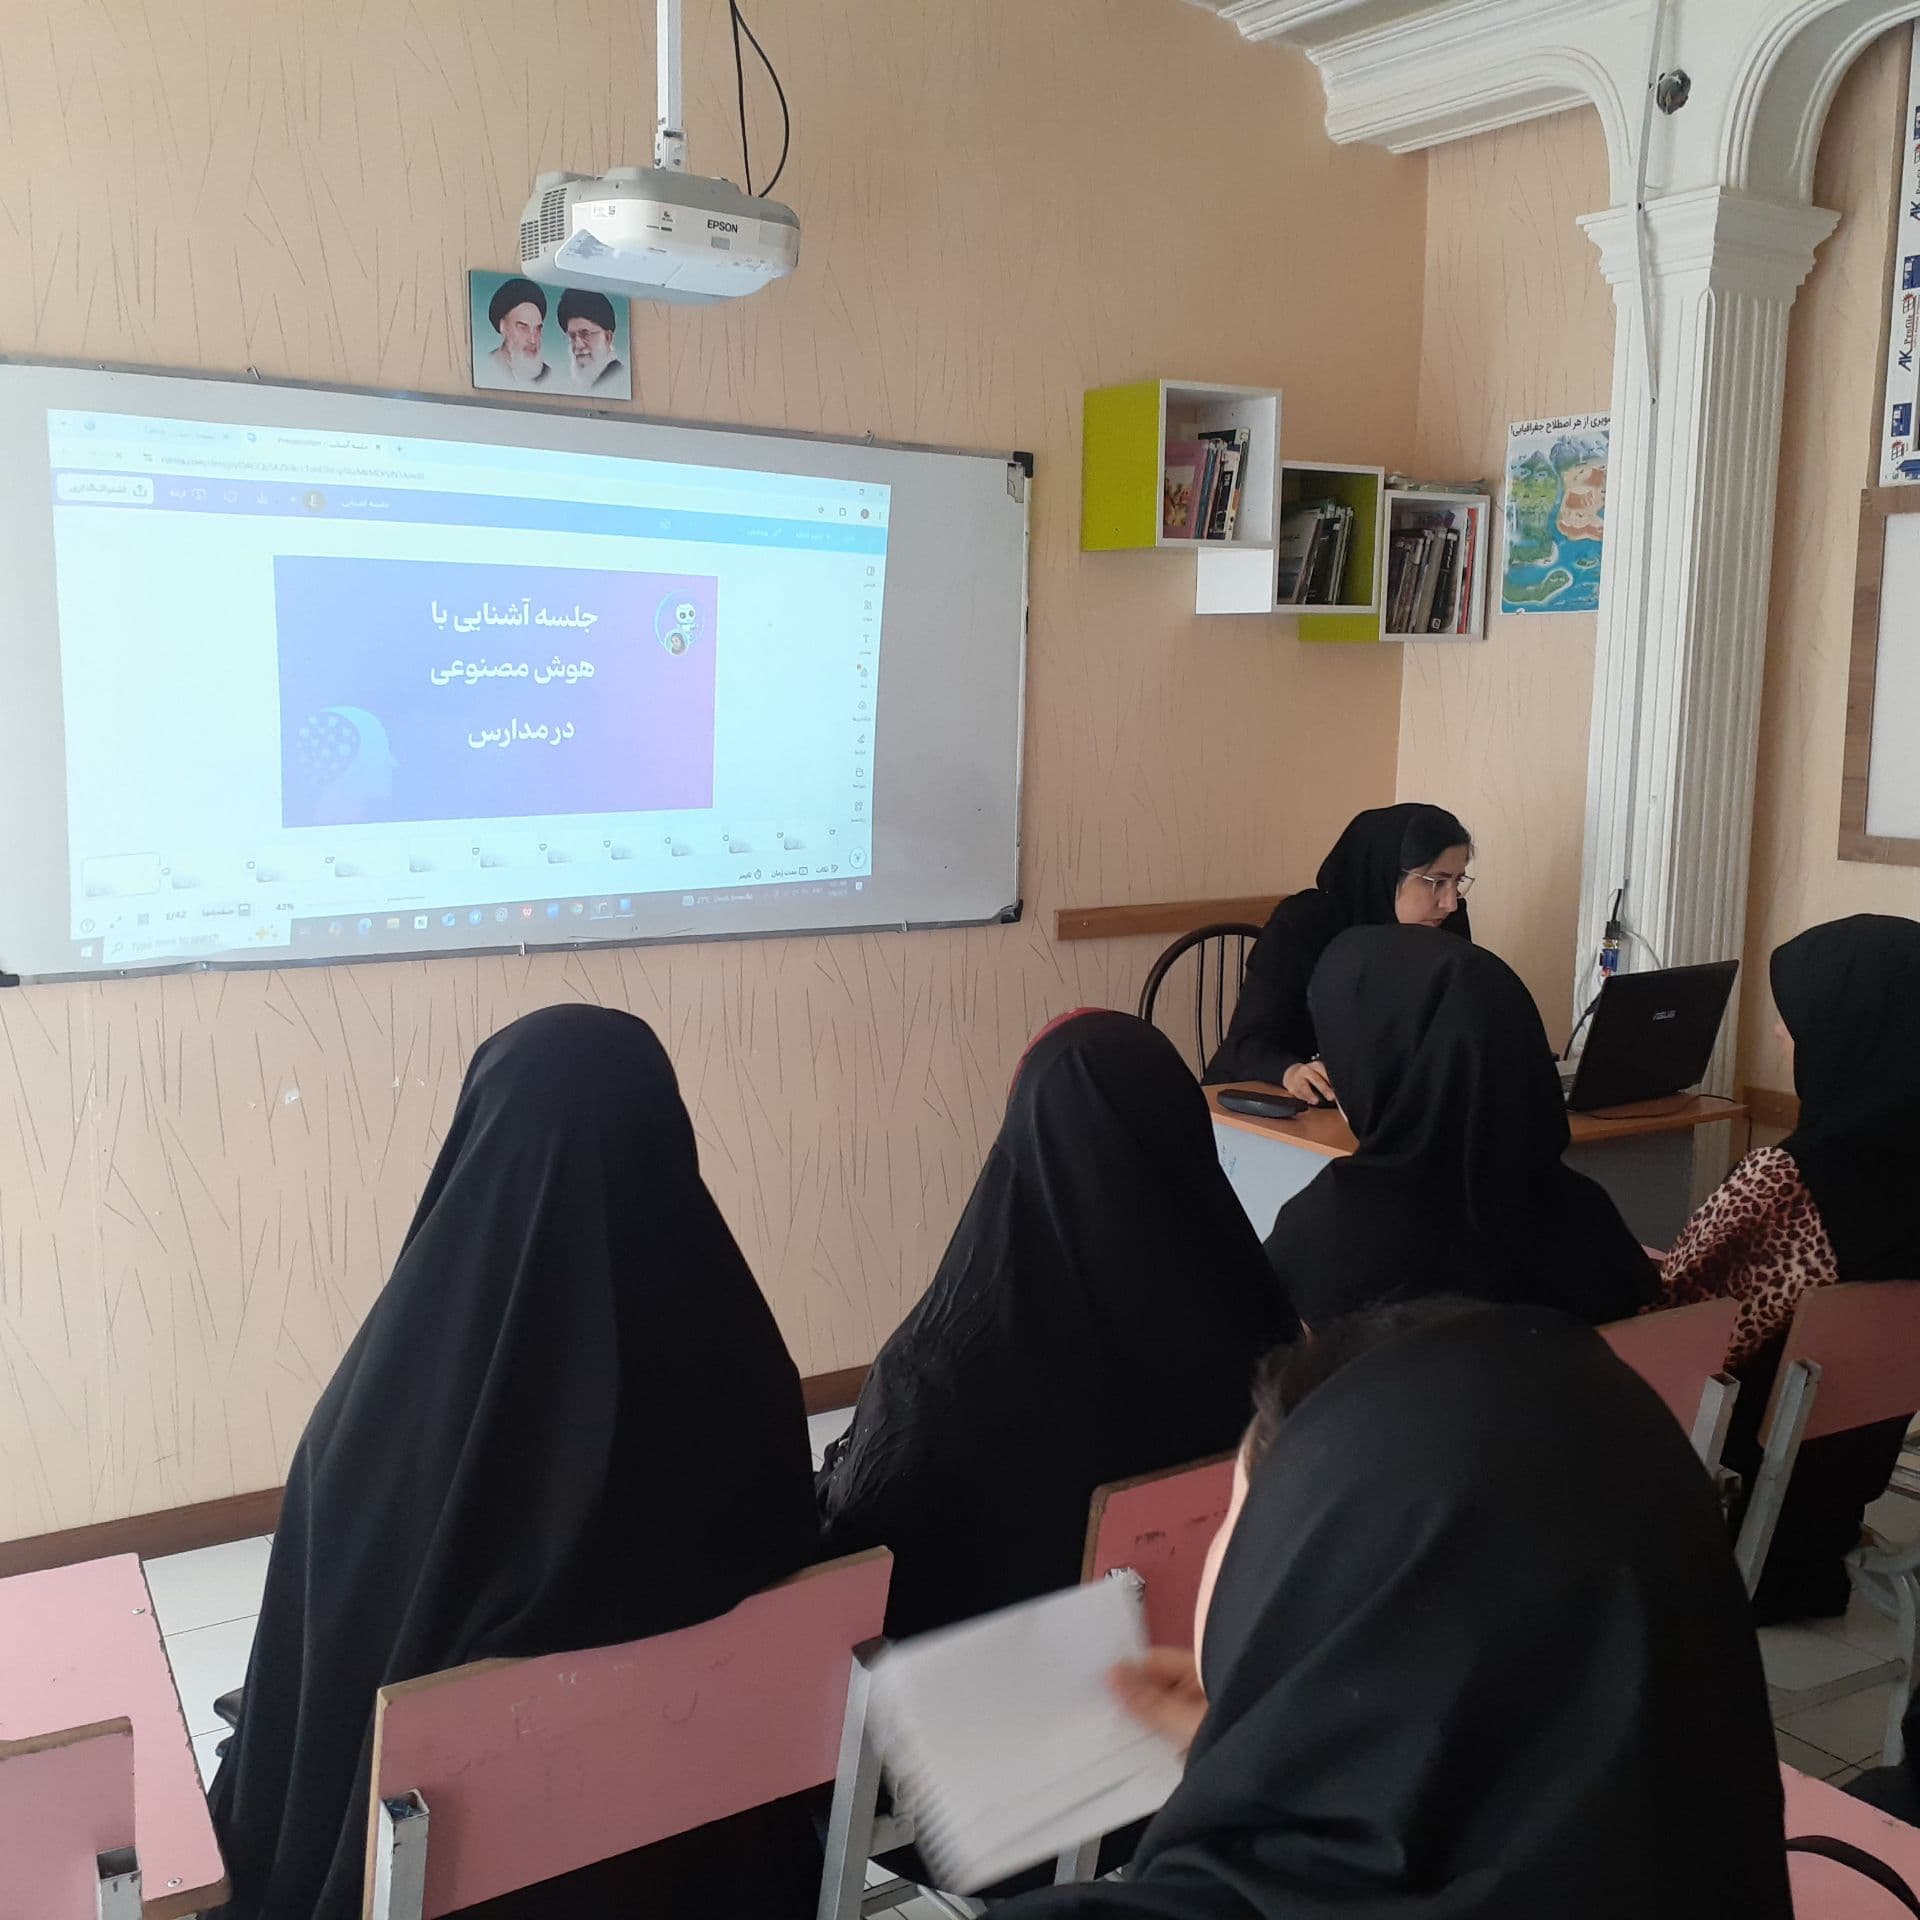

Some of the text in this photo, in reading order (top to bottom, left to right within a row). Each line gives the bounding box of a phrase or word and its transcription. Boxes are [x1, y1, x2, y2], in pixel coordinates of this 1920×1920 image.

[707, 219, 738, 234] EPSON
[1545, 417, 1572, 434] اصطلاح
[1573, 418, 1582, 430] هر
[431, 597, 598, 635] جلسه آشنایی با
[430, 655, 595, 685] هوش مصنوعی
[468, 718, 575, 748] در مدارس
